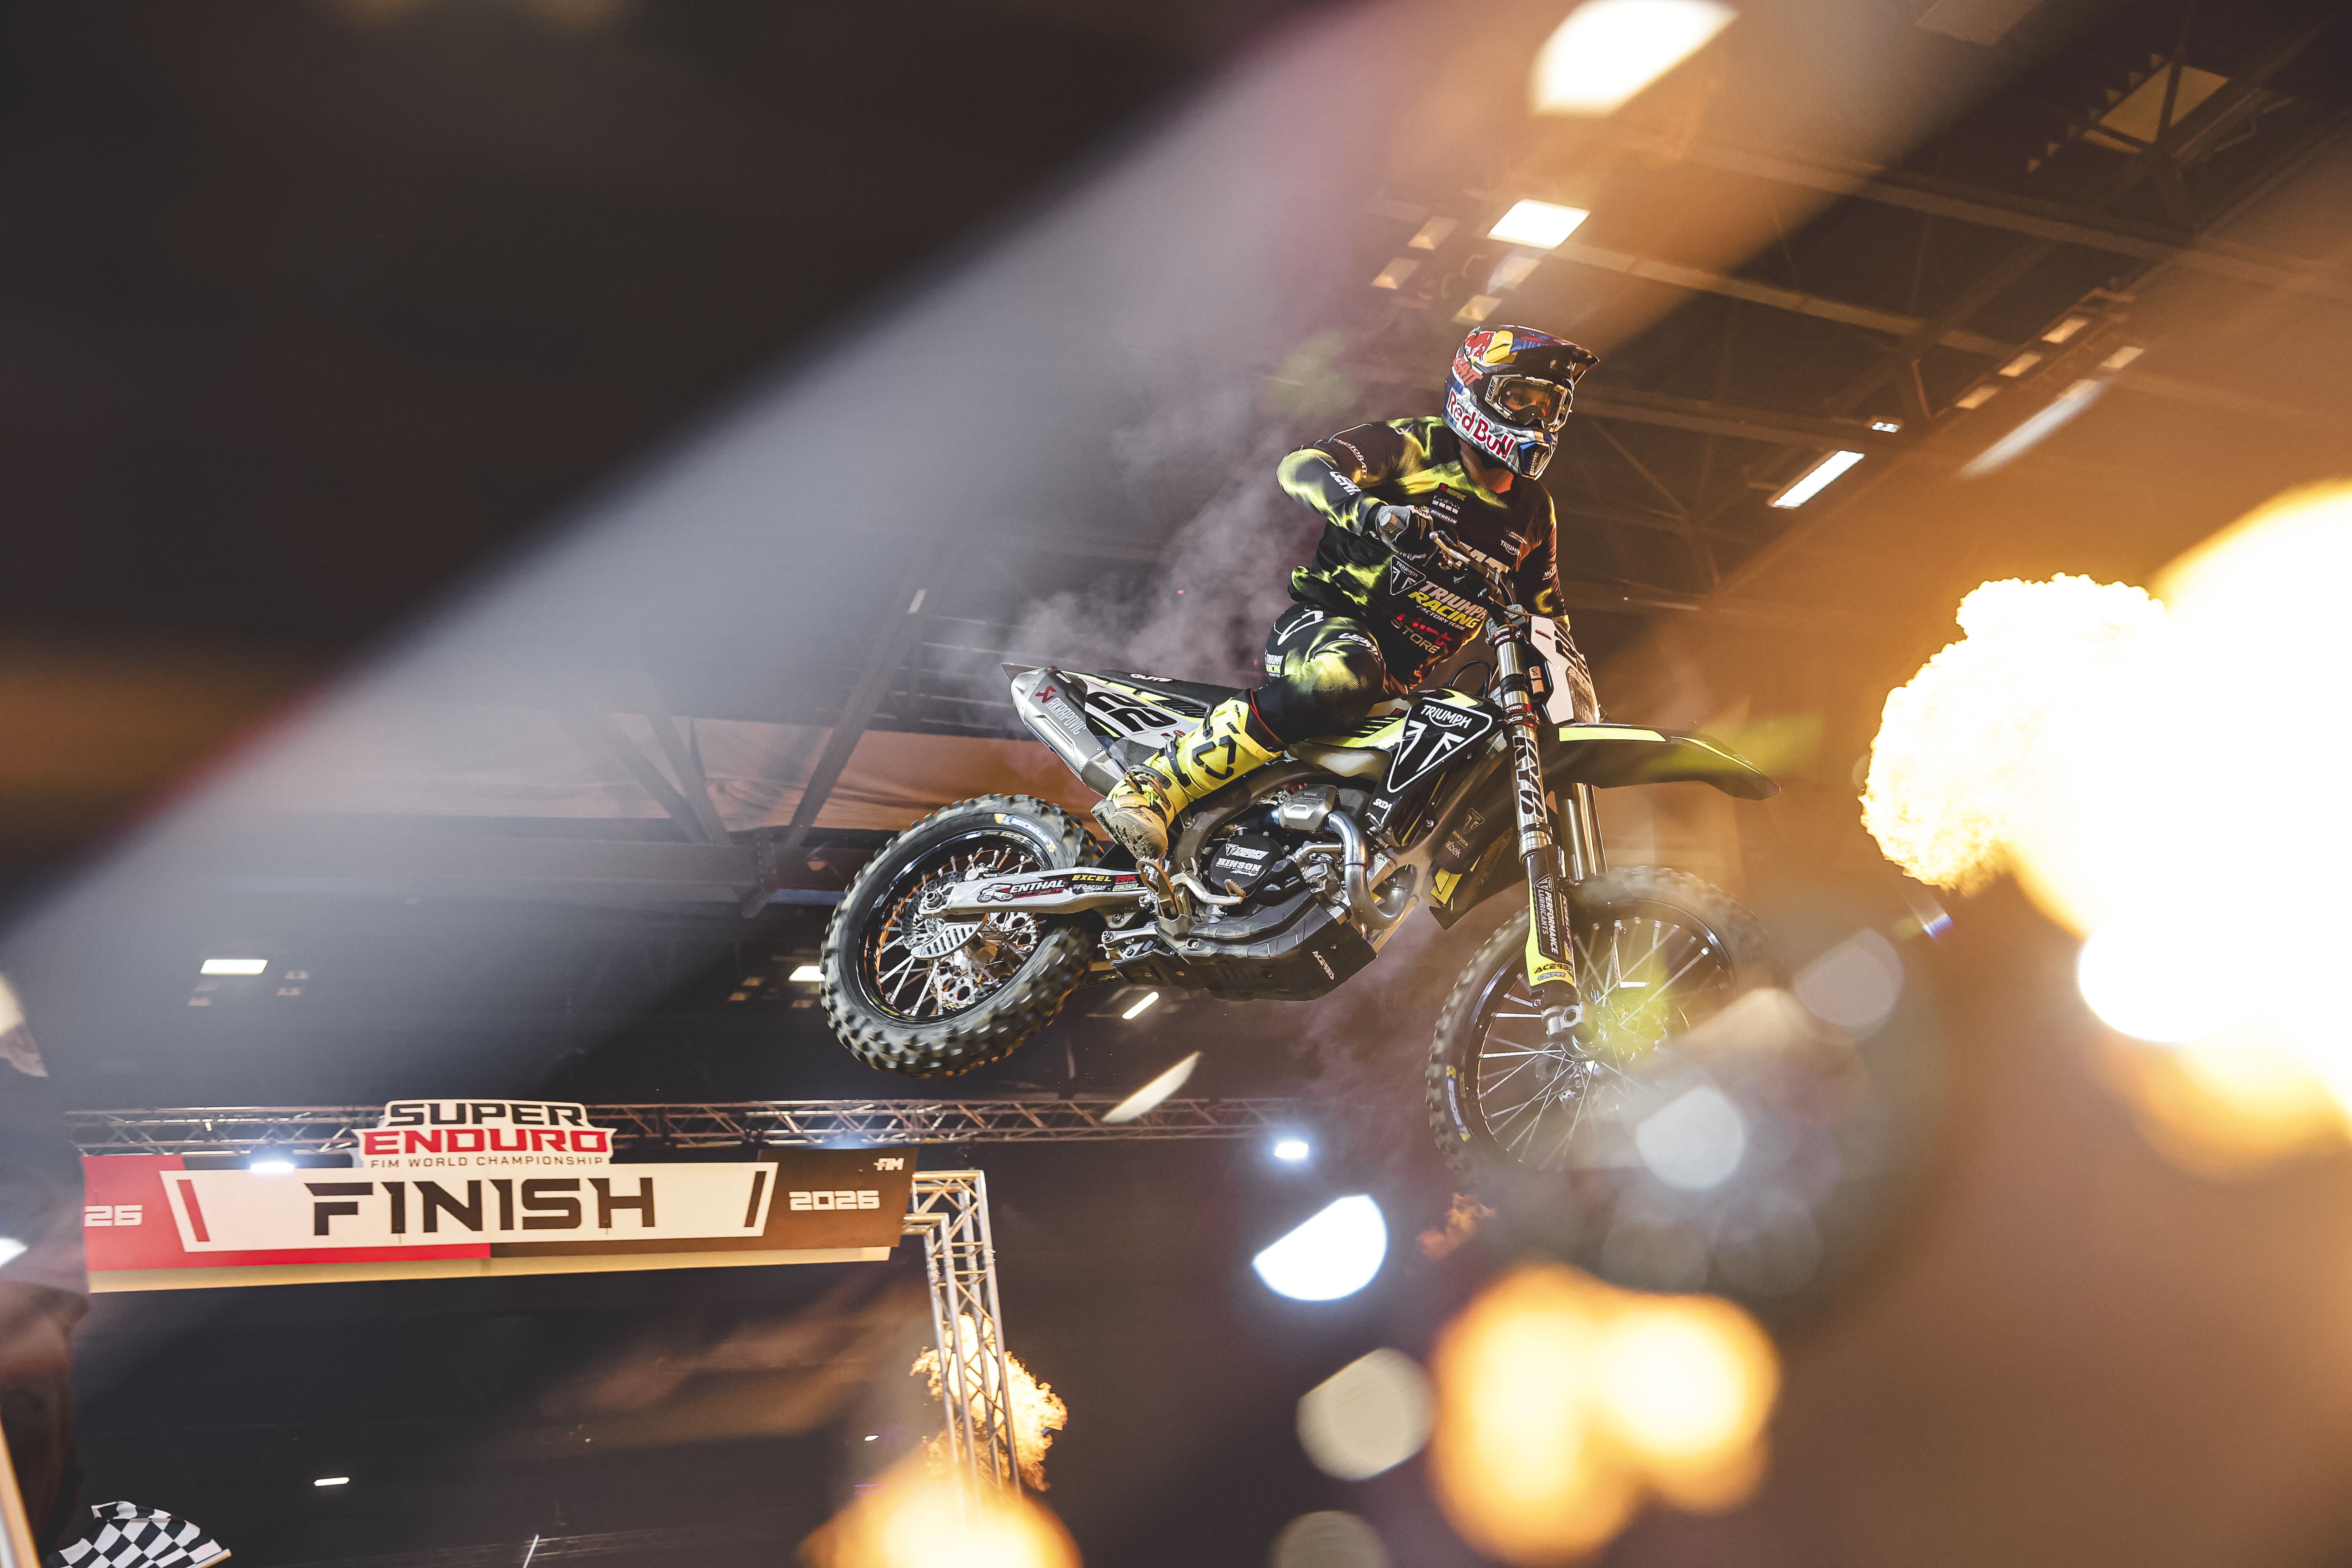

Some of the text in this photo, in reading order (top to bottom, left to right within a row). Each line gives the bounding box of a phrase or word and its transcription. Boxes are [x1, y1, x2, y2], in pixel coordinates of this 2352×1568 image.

[1448, 390, 1515, 459] Red Bull
[1430, 510, 1457, 524] MICHELIN
[1396, 561, 1418, 577] TRIUMPH
[1408, 591, 1481, 628] RACING
[1419, 581, 1488, 619] TRIUMPH
[1416, 606, 1450, 624] FACTORY
[1448, 621, 1465, 630] TEAM
[1391, 619, 1441, 653] STORE
[1421, 704, 1472, 729] TRIUMPH
[1452, 830, 1468, 847] HINSON
[1216, 858, 1262, 872] HINSON
[979, 879, 1065, 901] RENTHAL
[1538, 889, 1549, 935] LUBRICANTS
[1544, 891, 1559, 955] PERFORMANCE
[386, 1103, 585, 1127] SUPER
[363, 1128, 608, 1155] ENDURO
[371, 1156, 603, 1168] FIM WORLD CHAMPIONSHIP
[303, 1177, 656, 1236] FINISH
[789, 1190, 880, 1211] 2026
